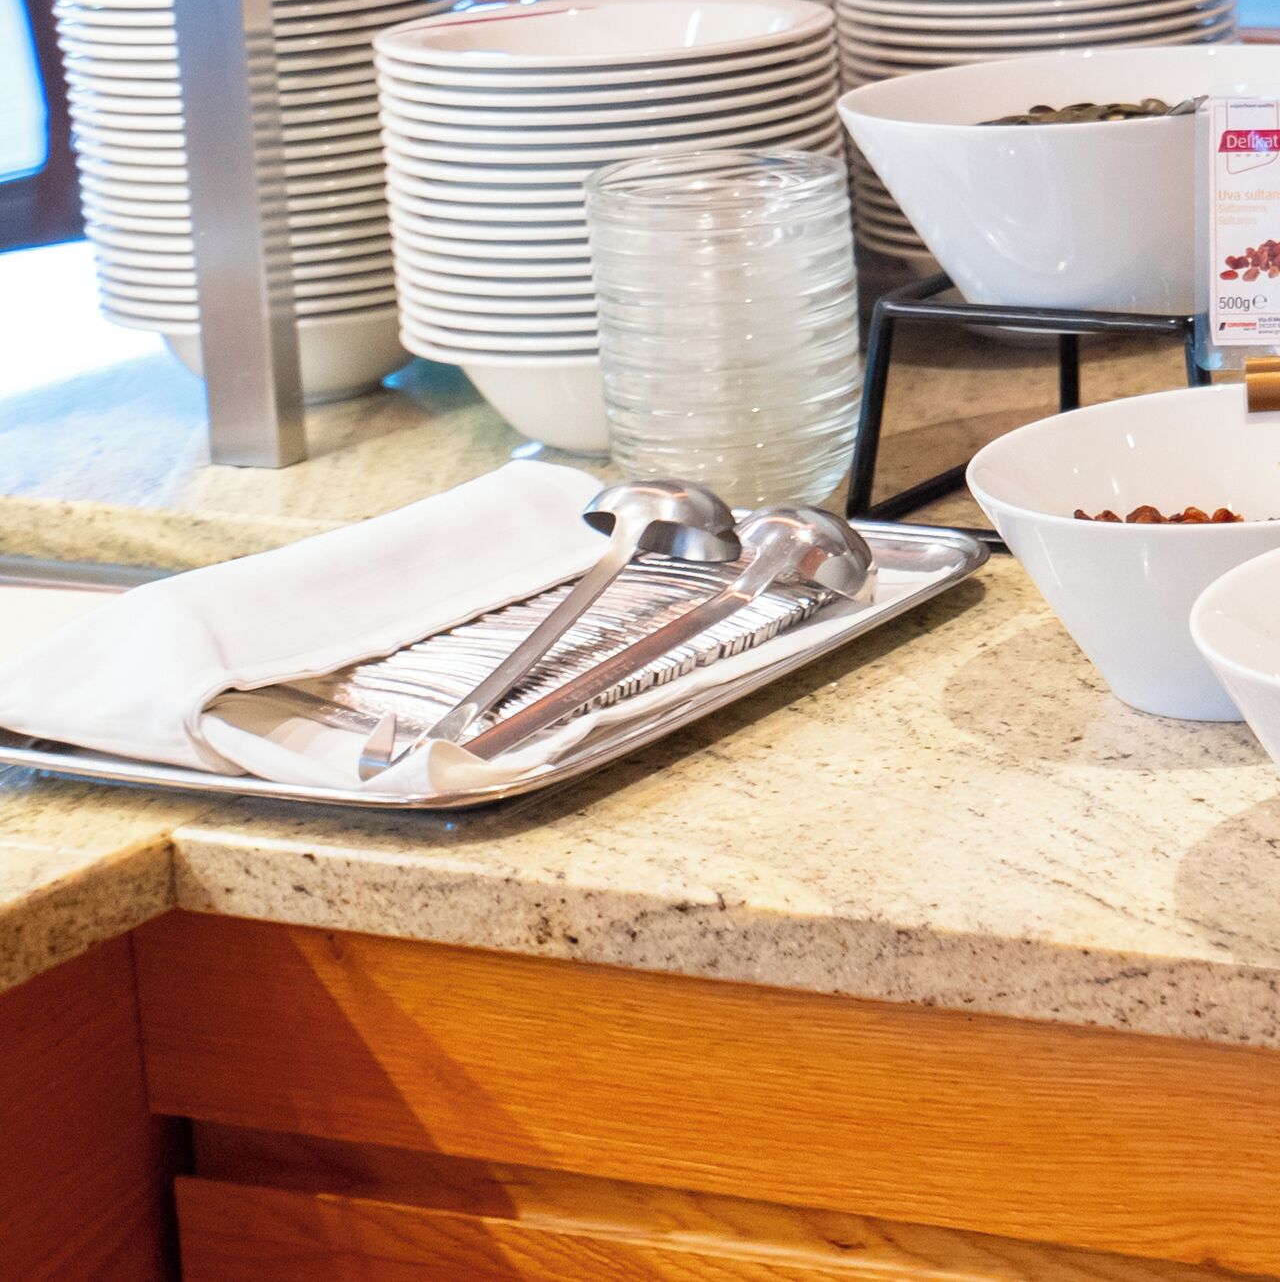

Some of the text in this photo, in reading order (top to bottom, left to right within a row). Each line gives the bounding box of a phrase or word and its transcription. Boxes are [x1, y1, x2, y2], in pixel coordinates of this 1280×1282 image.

[1226, 133, 1279, 148] Delikat
[1218, 190, 1240, 200] Uva
[1218, 297, 1250, 312] 500g
